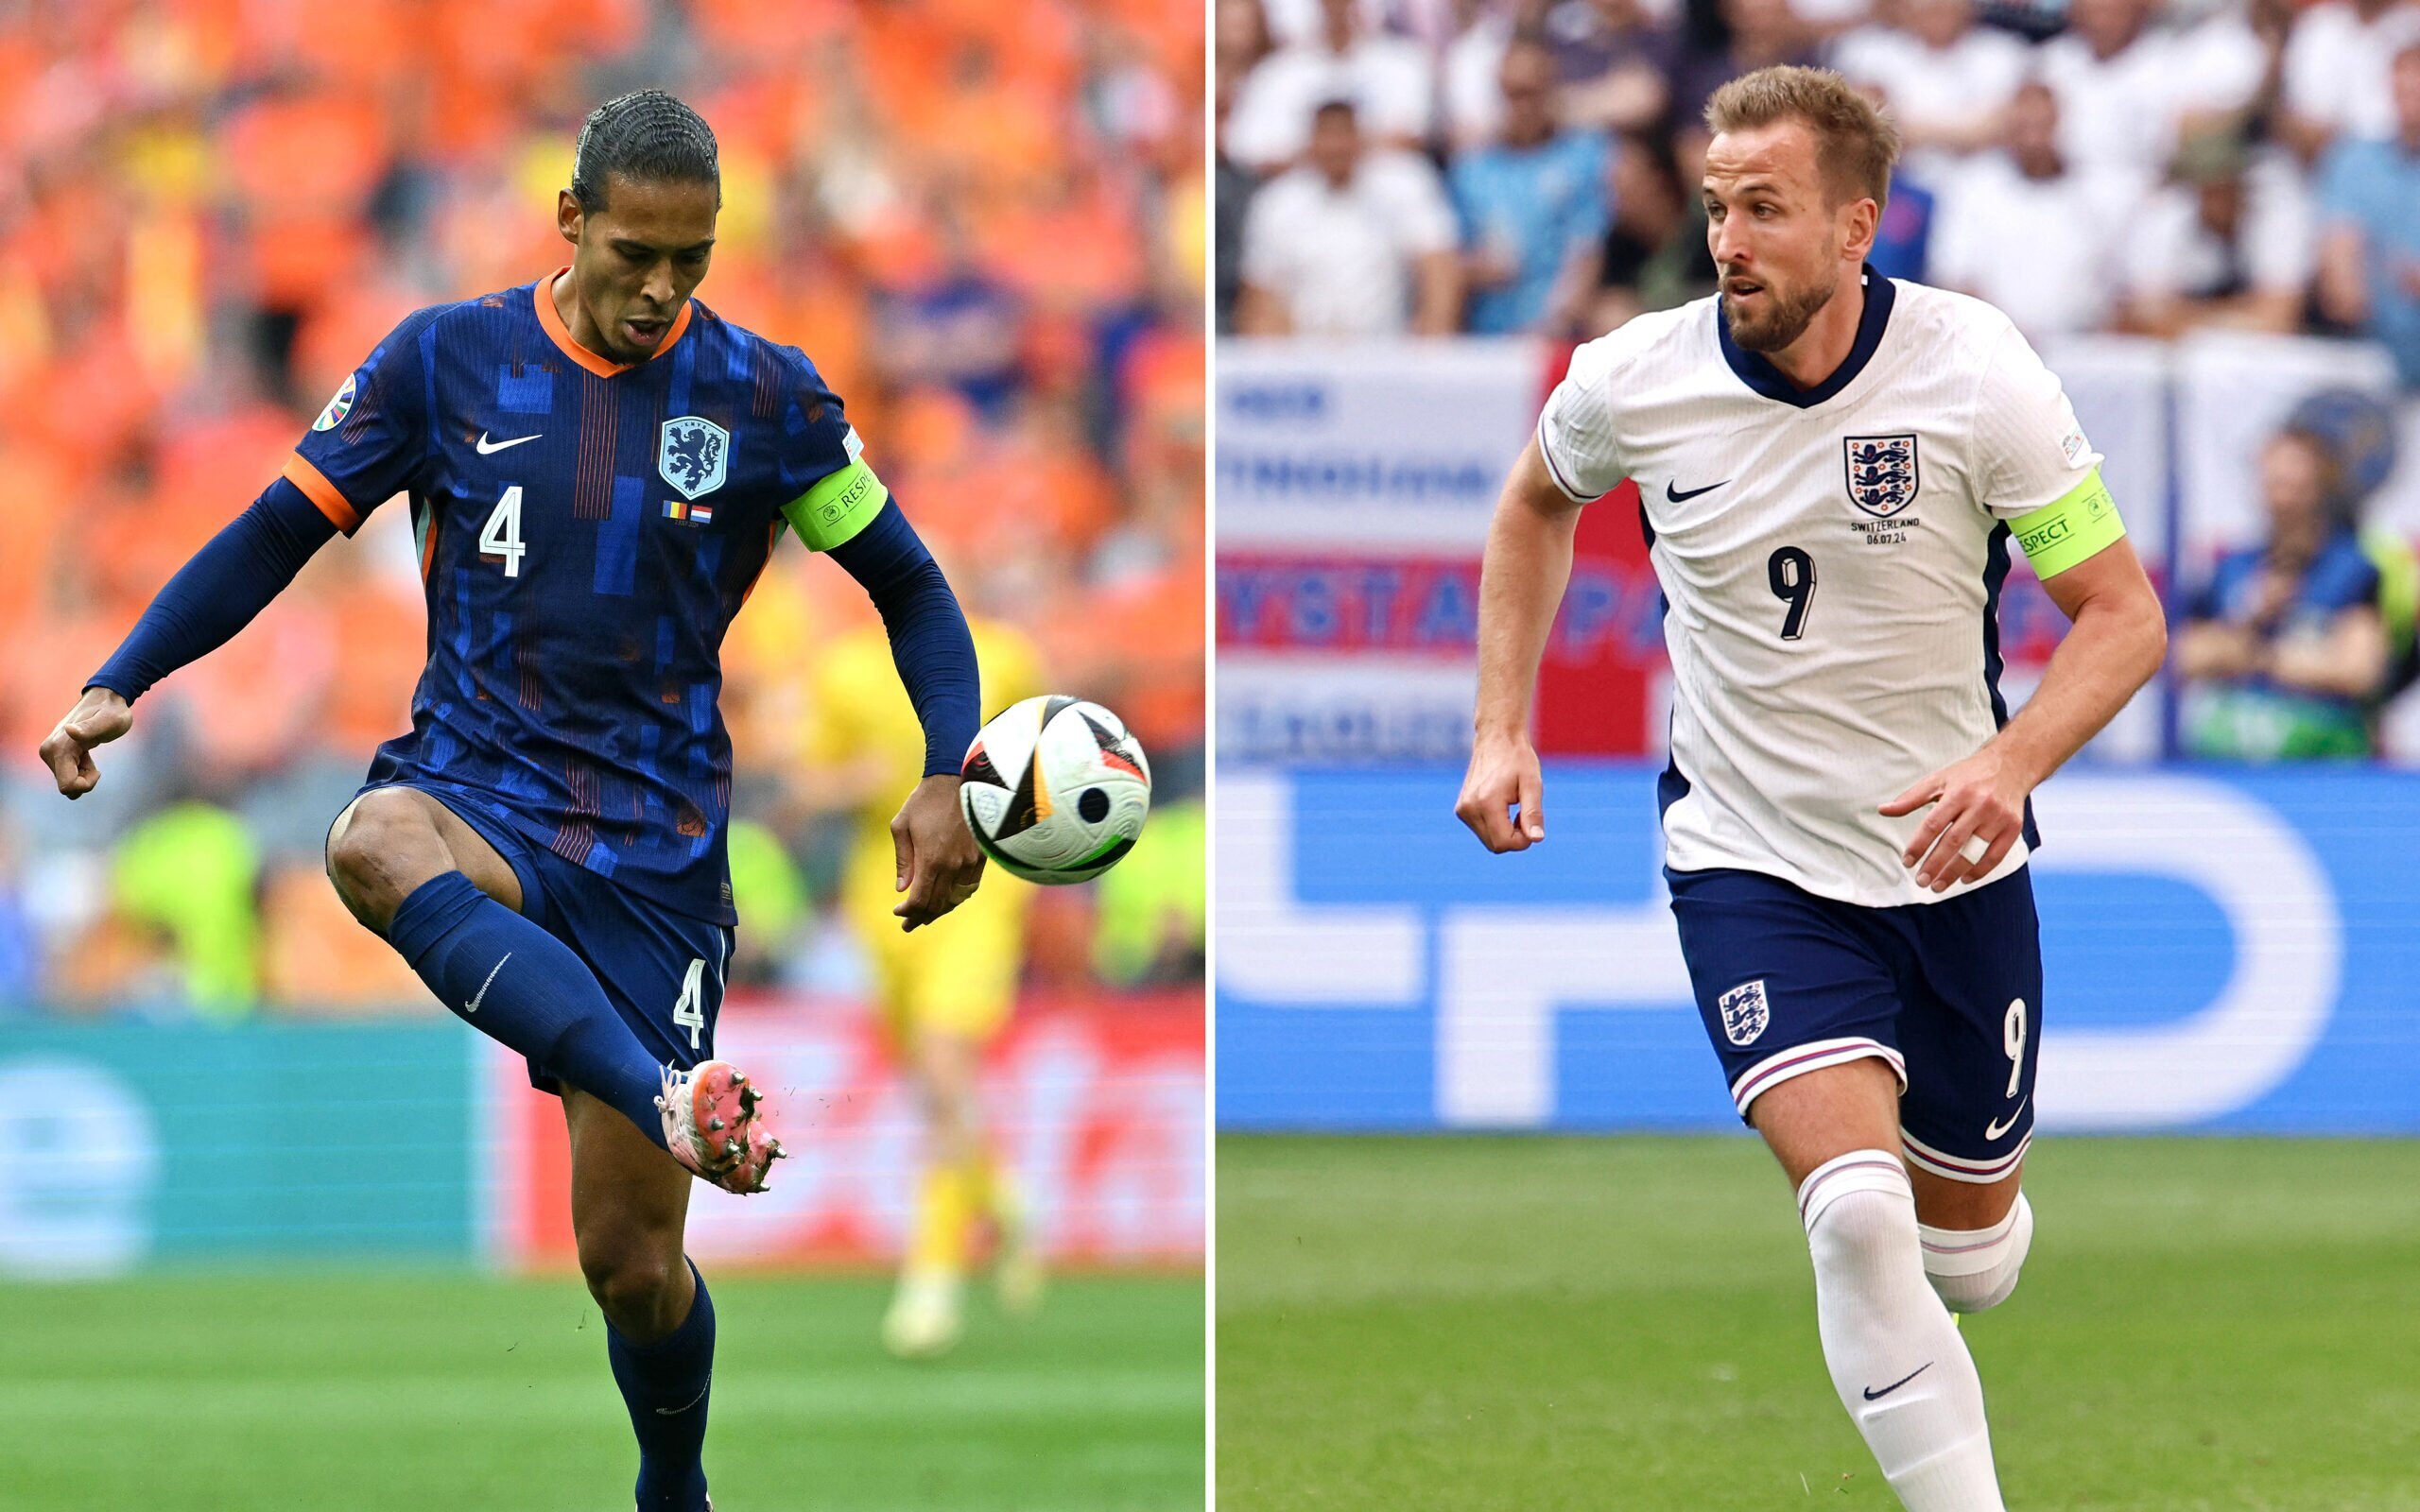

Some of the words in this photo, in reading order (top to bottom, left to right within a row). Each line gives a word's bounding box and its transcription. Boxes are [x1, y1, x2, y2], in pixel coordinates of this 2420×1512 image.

[479, 486, 526, 576] 4
[1851, 518, 1920, 532] SWITZERLAND
[1867, 531, 1907, 545] 06.07.24
[1768, 546, 1817, 640] 9
[673, 958, 706, 1049] 4
[2005, 998, 2027, 1098] 9
